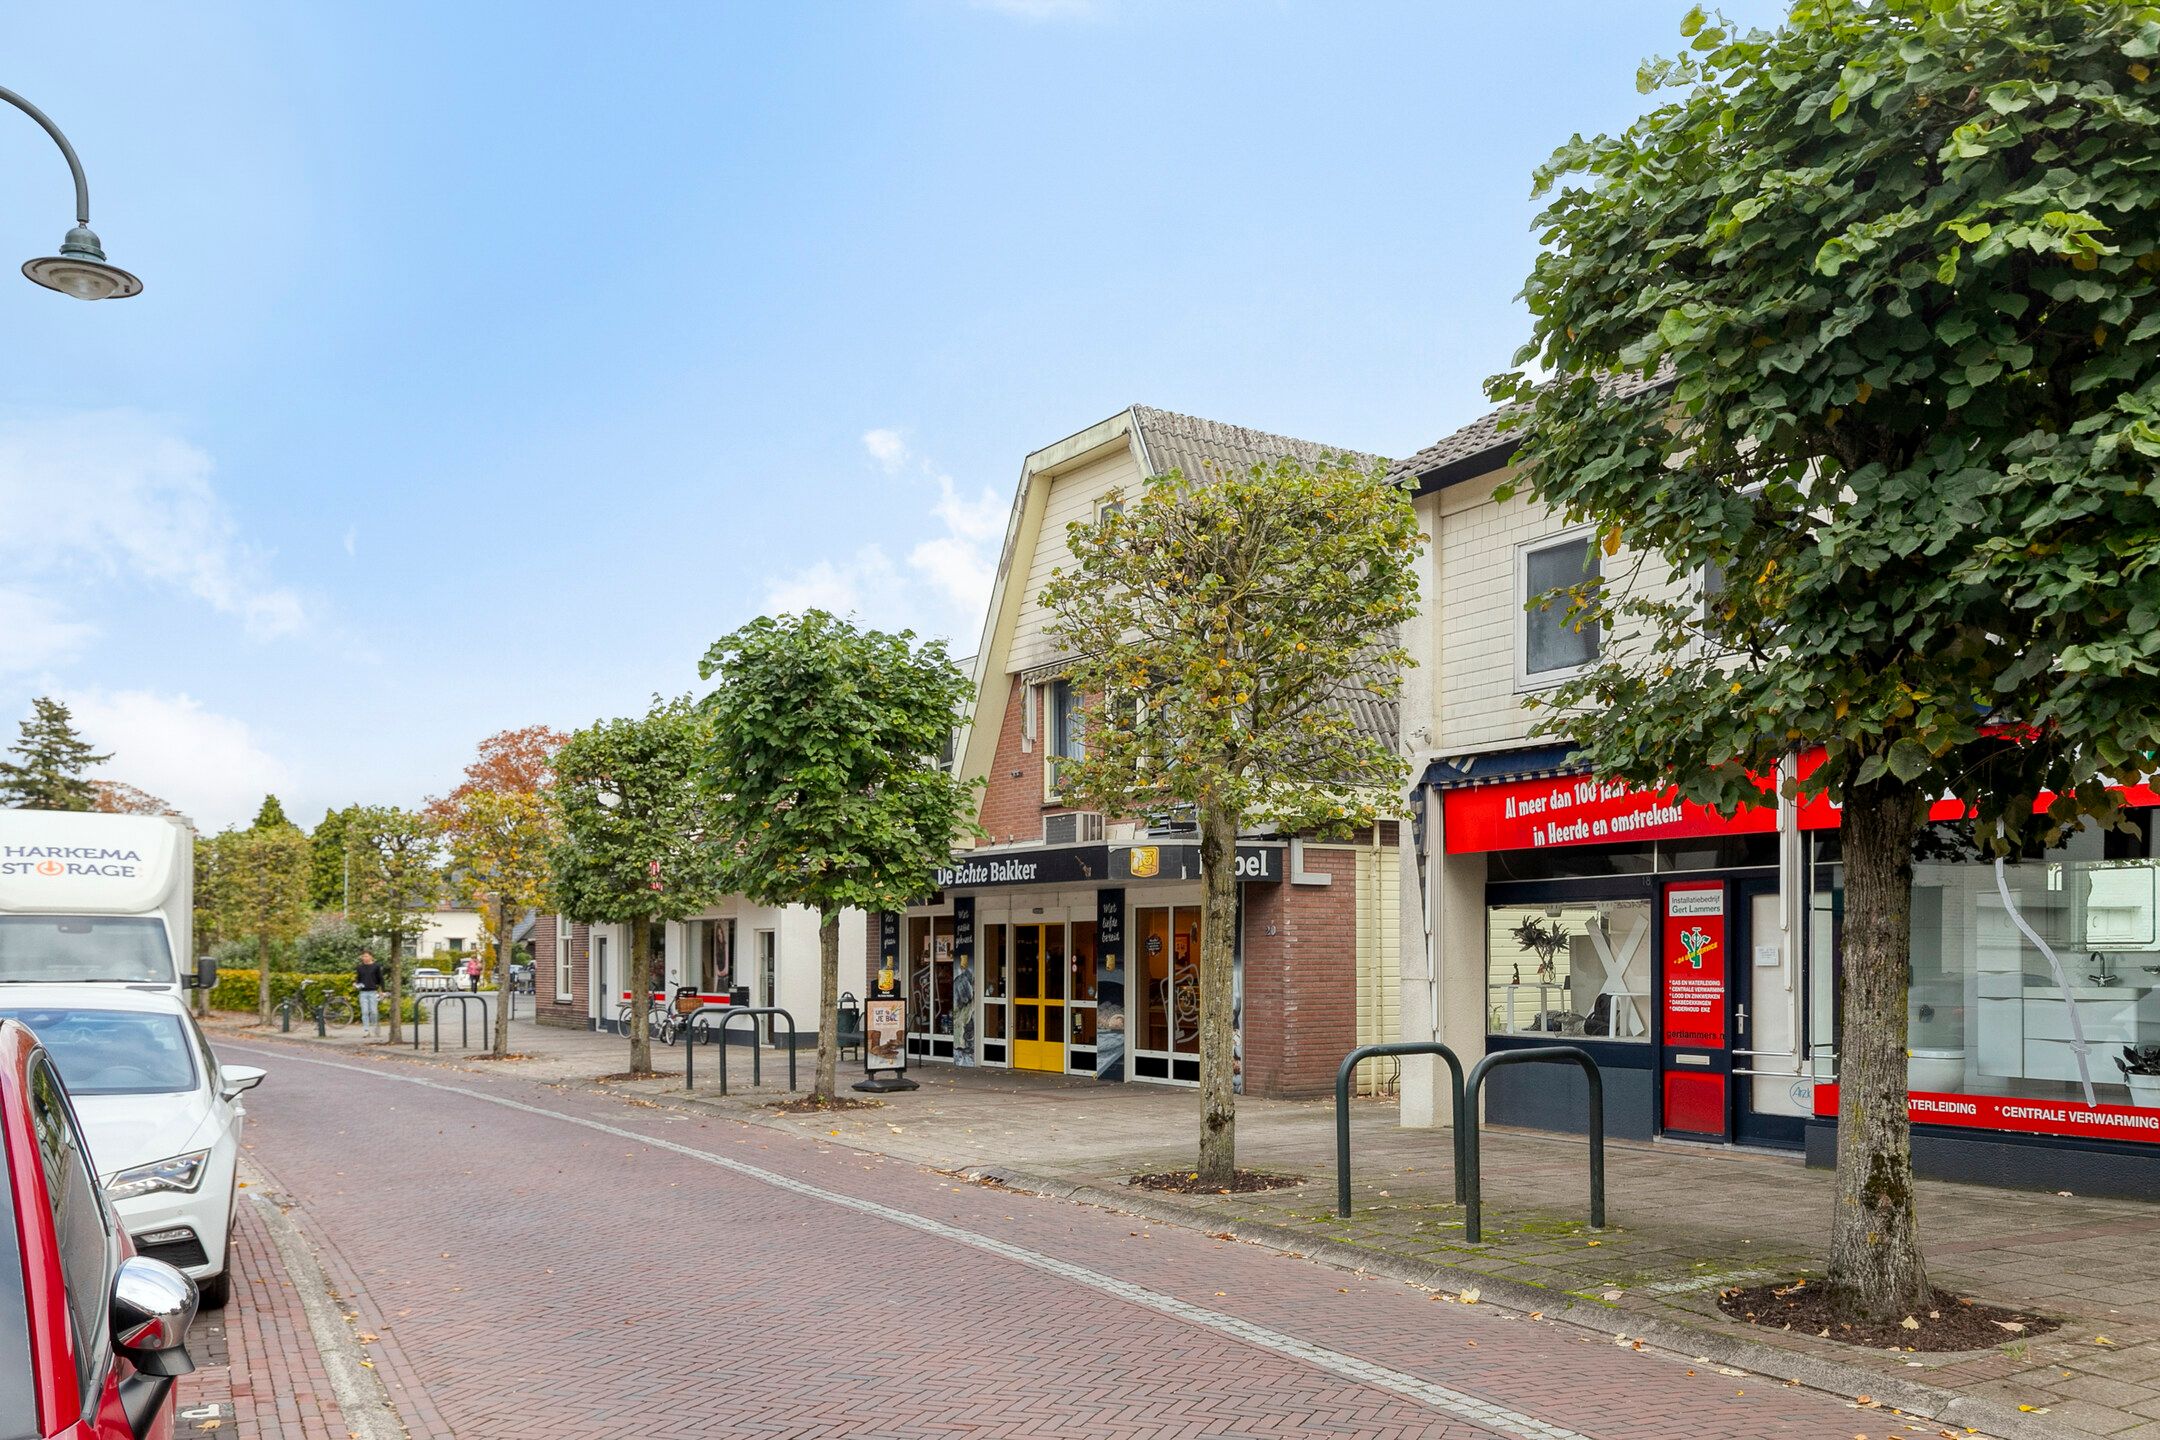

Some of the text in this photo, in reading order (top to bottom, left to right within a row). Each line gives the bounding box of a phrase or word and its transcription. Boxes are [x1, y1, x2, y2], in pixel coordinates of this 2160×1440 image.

[1505, 796, 1516, 819] Al
[1519, 795, 1547, 816] meer
[1550, 788, 1572, 810] dan
[1574, 780, 1597, 806] 100
[1533, 802, 1683, 847] in Heerde en omstreken!
[4, 845, 141, 862] HARKEMA
[2, 860, 136, 878] STORAGE
[937, 859, 1037, 885] De Echte Bakker
[1642, 875, 1651, 886] 18
[1671, 895, 1721, 904] Installatiebedrijf
[1672, 904, 1721, 914] Gert Lammers
[1265, 925, 1277, 937] 20
[2001, 1105, 2066, 1122] CENTRALE
[2068, 1110, 2160, 1130] VERWARMING
